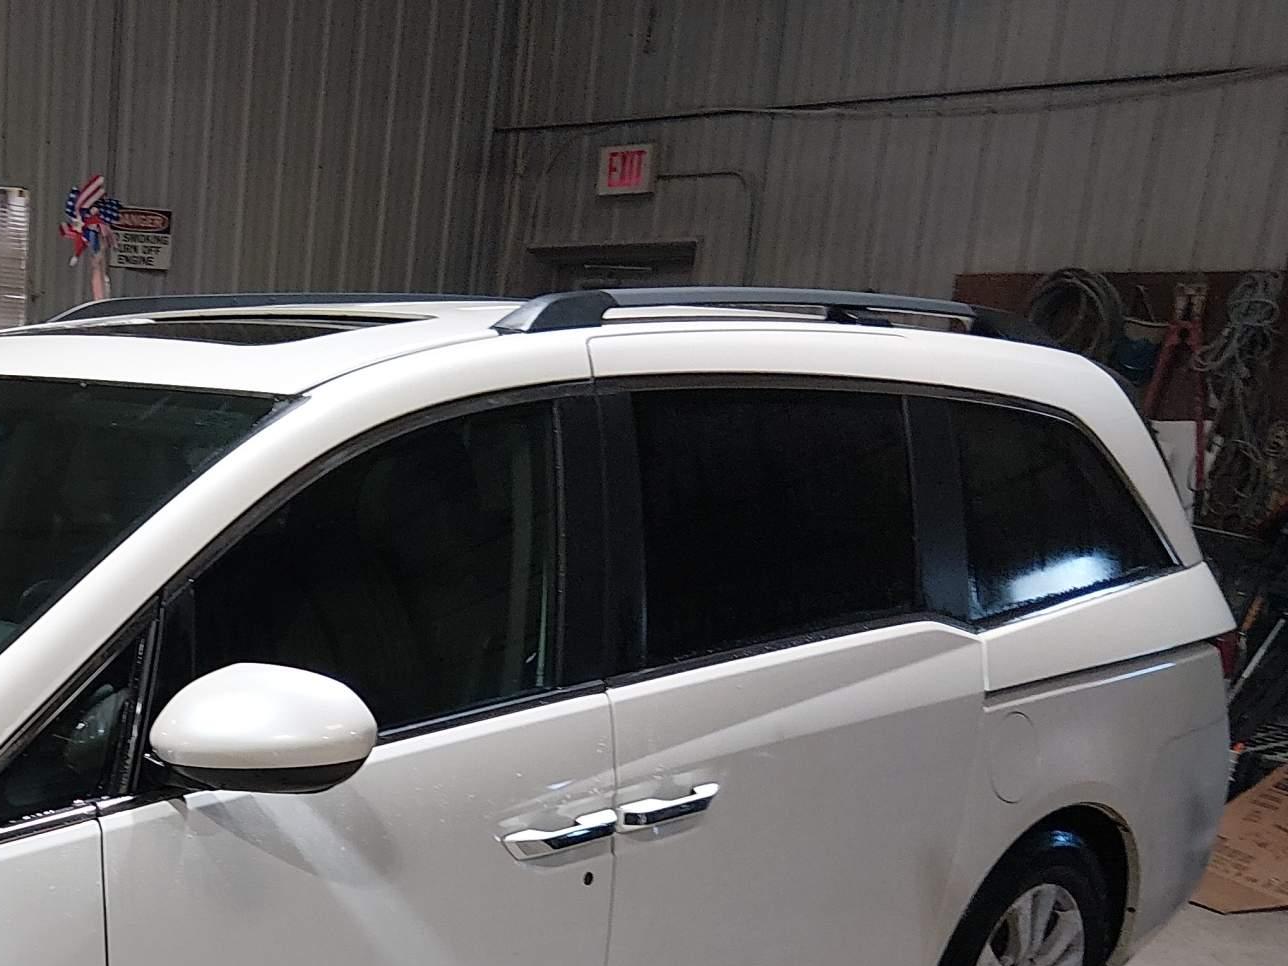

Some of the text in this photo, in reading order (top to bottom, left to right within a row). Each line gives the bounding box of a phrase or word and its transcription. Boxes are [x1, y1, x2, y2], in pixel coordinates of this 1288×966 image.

[607, 150, 647, 188] EXIT
[117, 211, 165, 228] ANGER
[122, 233, 169, 245] SMOKING
[116, 243, 163, 255] URN OFF
[117, 254, 155, 266] ENGINE
